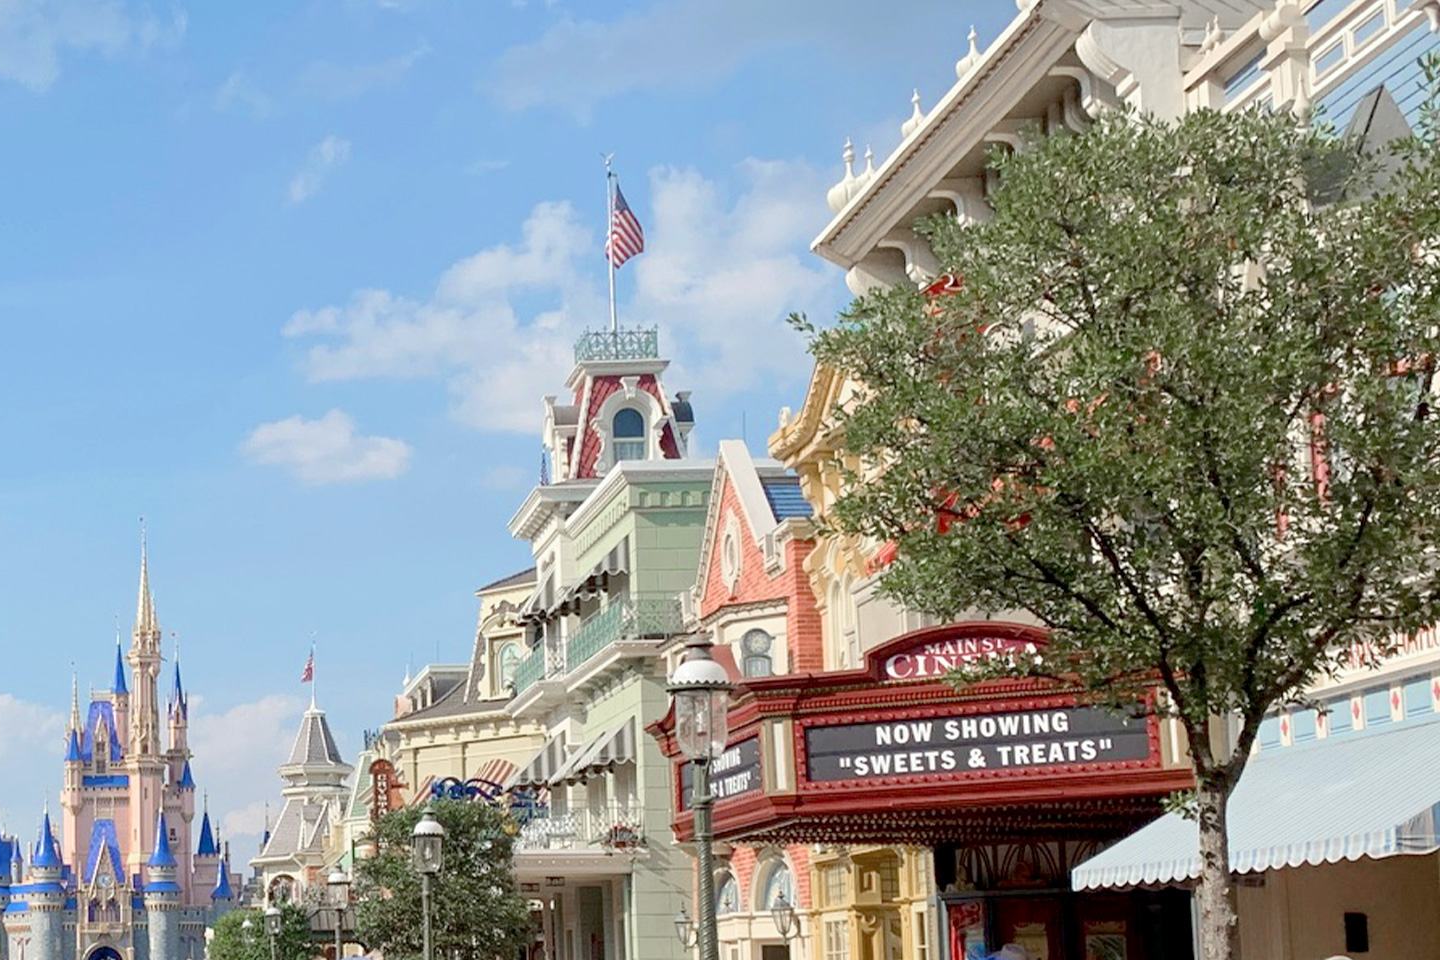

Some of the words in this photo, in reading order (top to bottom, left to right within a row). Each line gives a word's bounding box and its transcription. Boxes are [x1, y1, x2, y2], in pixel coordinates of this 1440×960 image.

[924, 638, 977, 656] MAIN
[876, 721, 933, 746] NOW
[944, 711, 1069, 740] SHOWING
[839, 750, 956, 777] "SWEETS
[968, 747, 987, 769] &
[997, 738, 1113, 768] TREATS"
